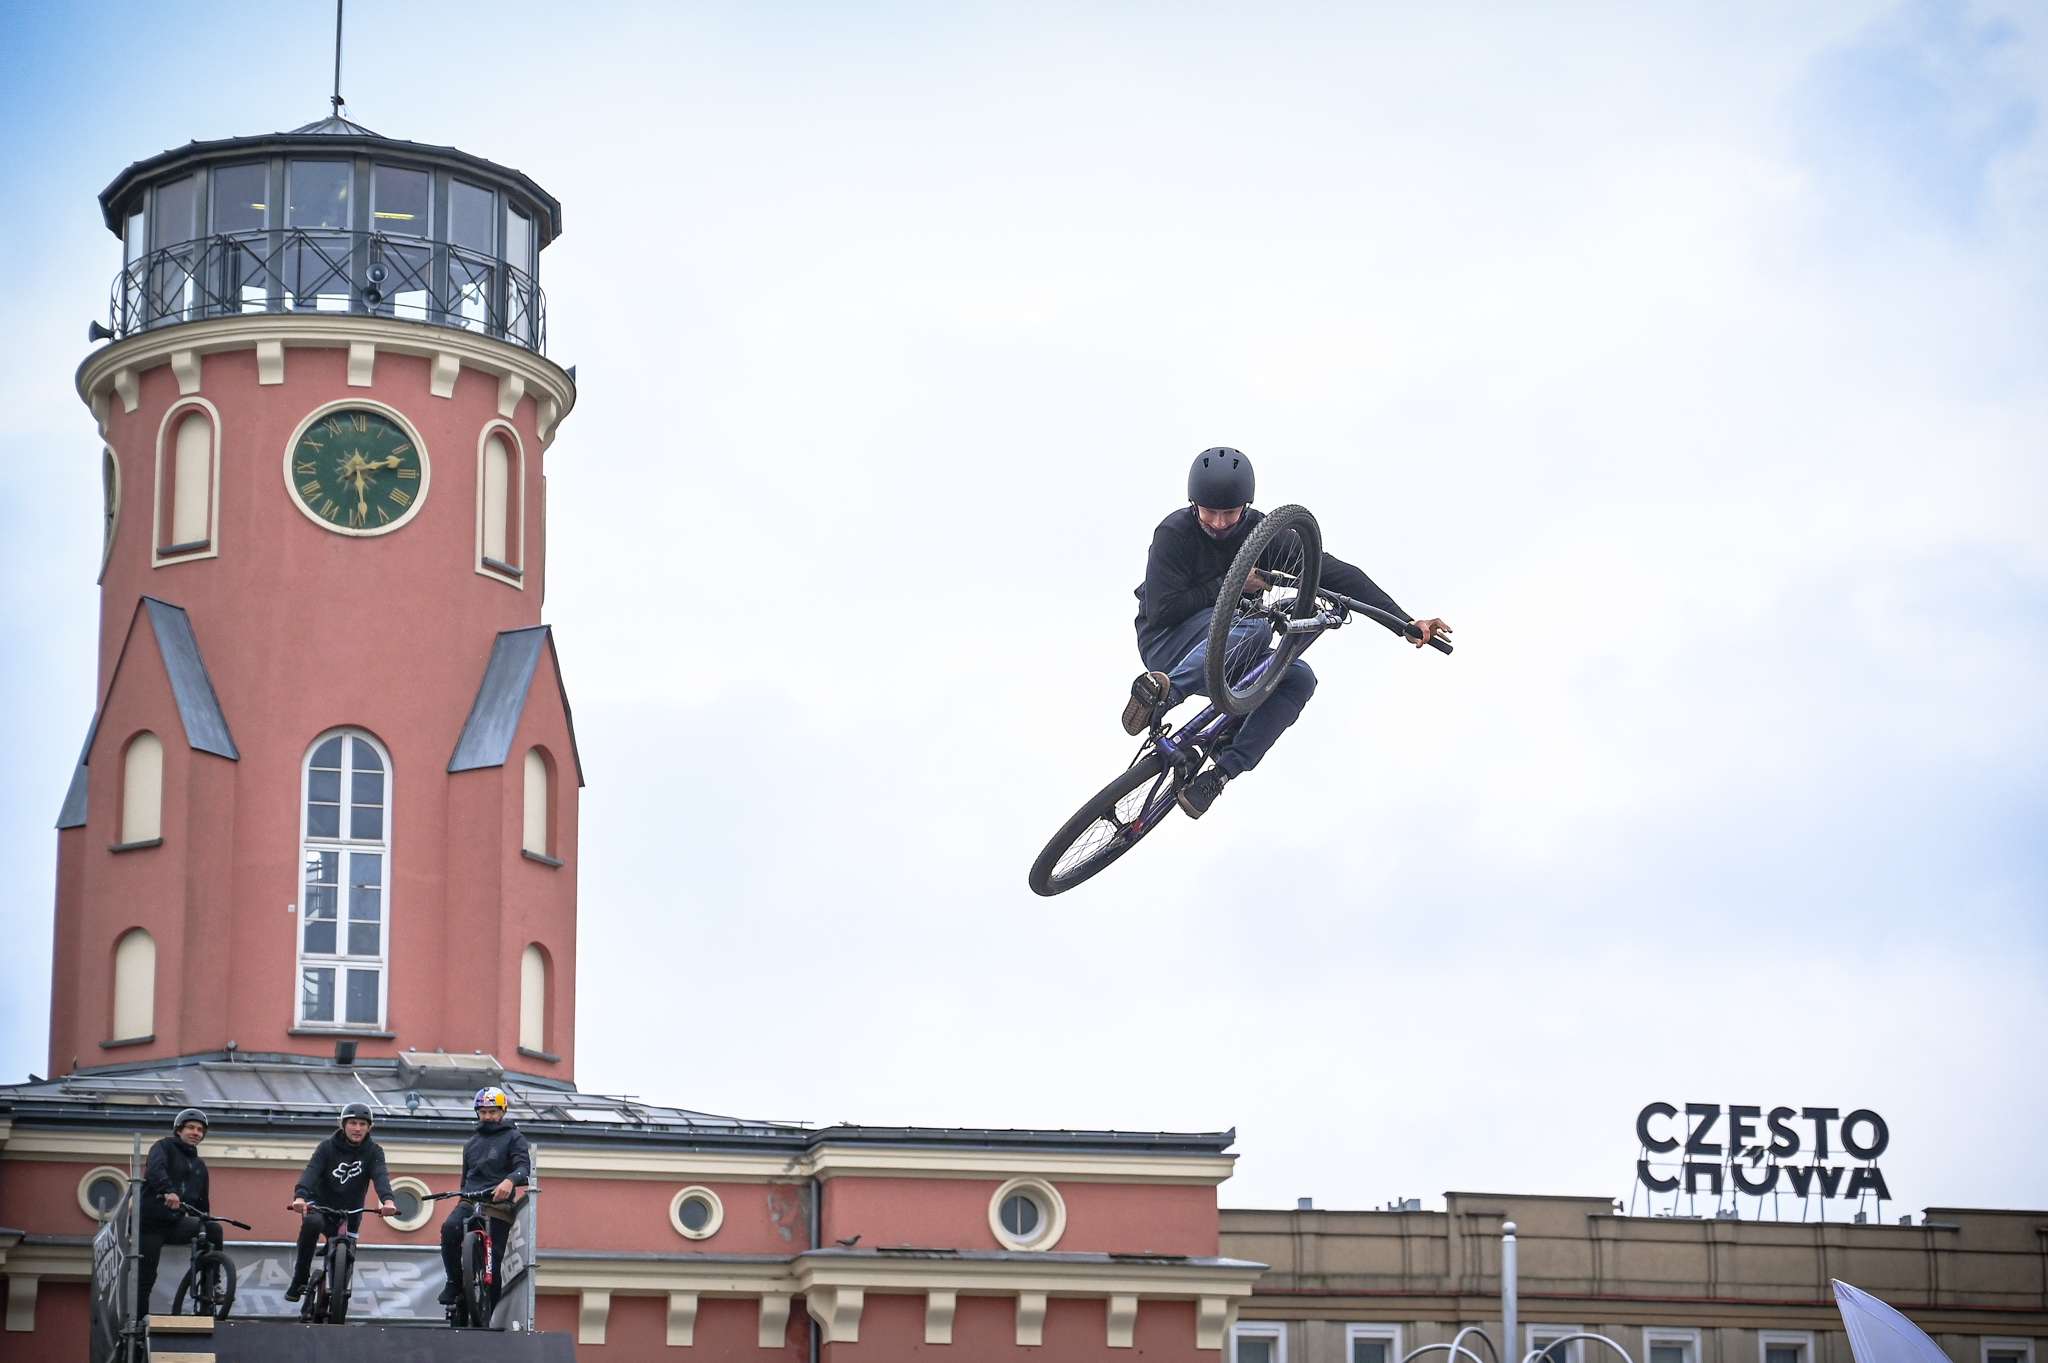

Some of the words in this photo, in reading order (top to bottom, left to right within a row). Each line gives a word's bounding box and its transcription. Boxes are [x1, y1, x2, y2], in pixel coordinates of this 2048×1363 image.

[350, 415, 369, 432] XII
[397, 468, 417, 479] III
[1636, 1101, 1890, 1161] CZĘSTO
